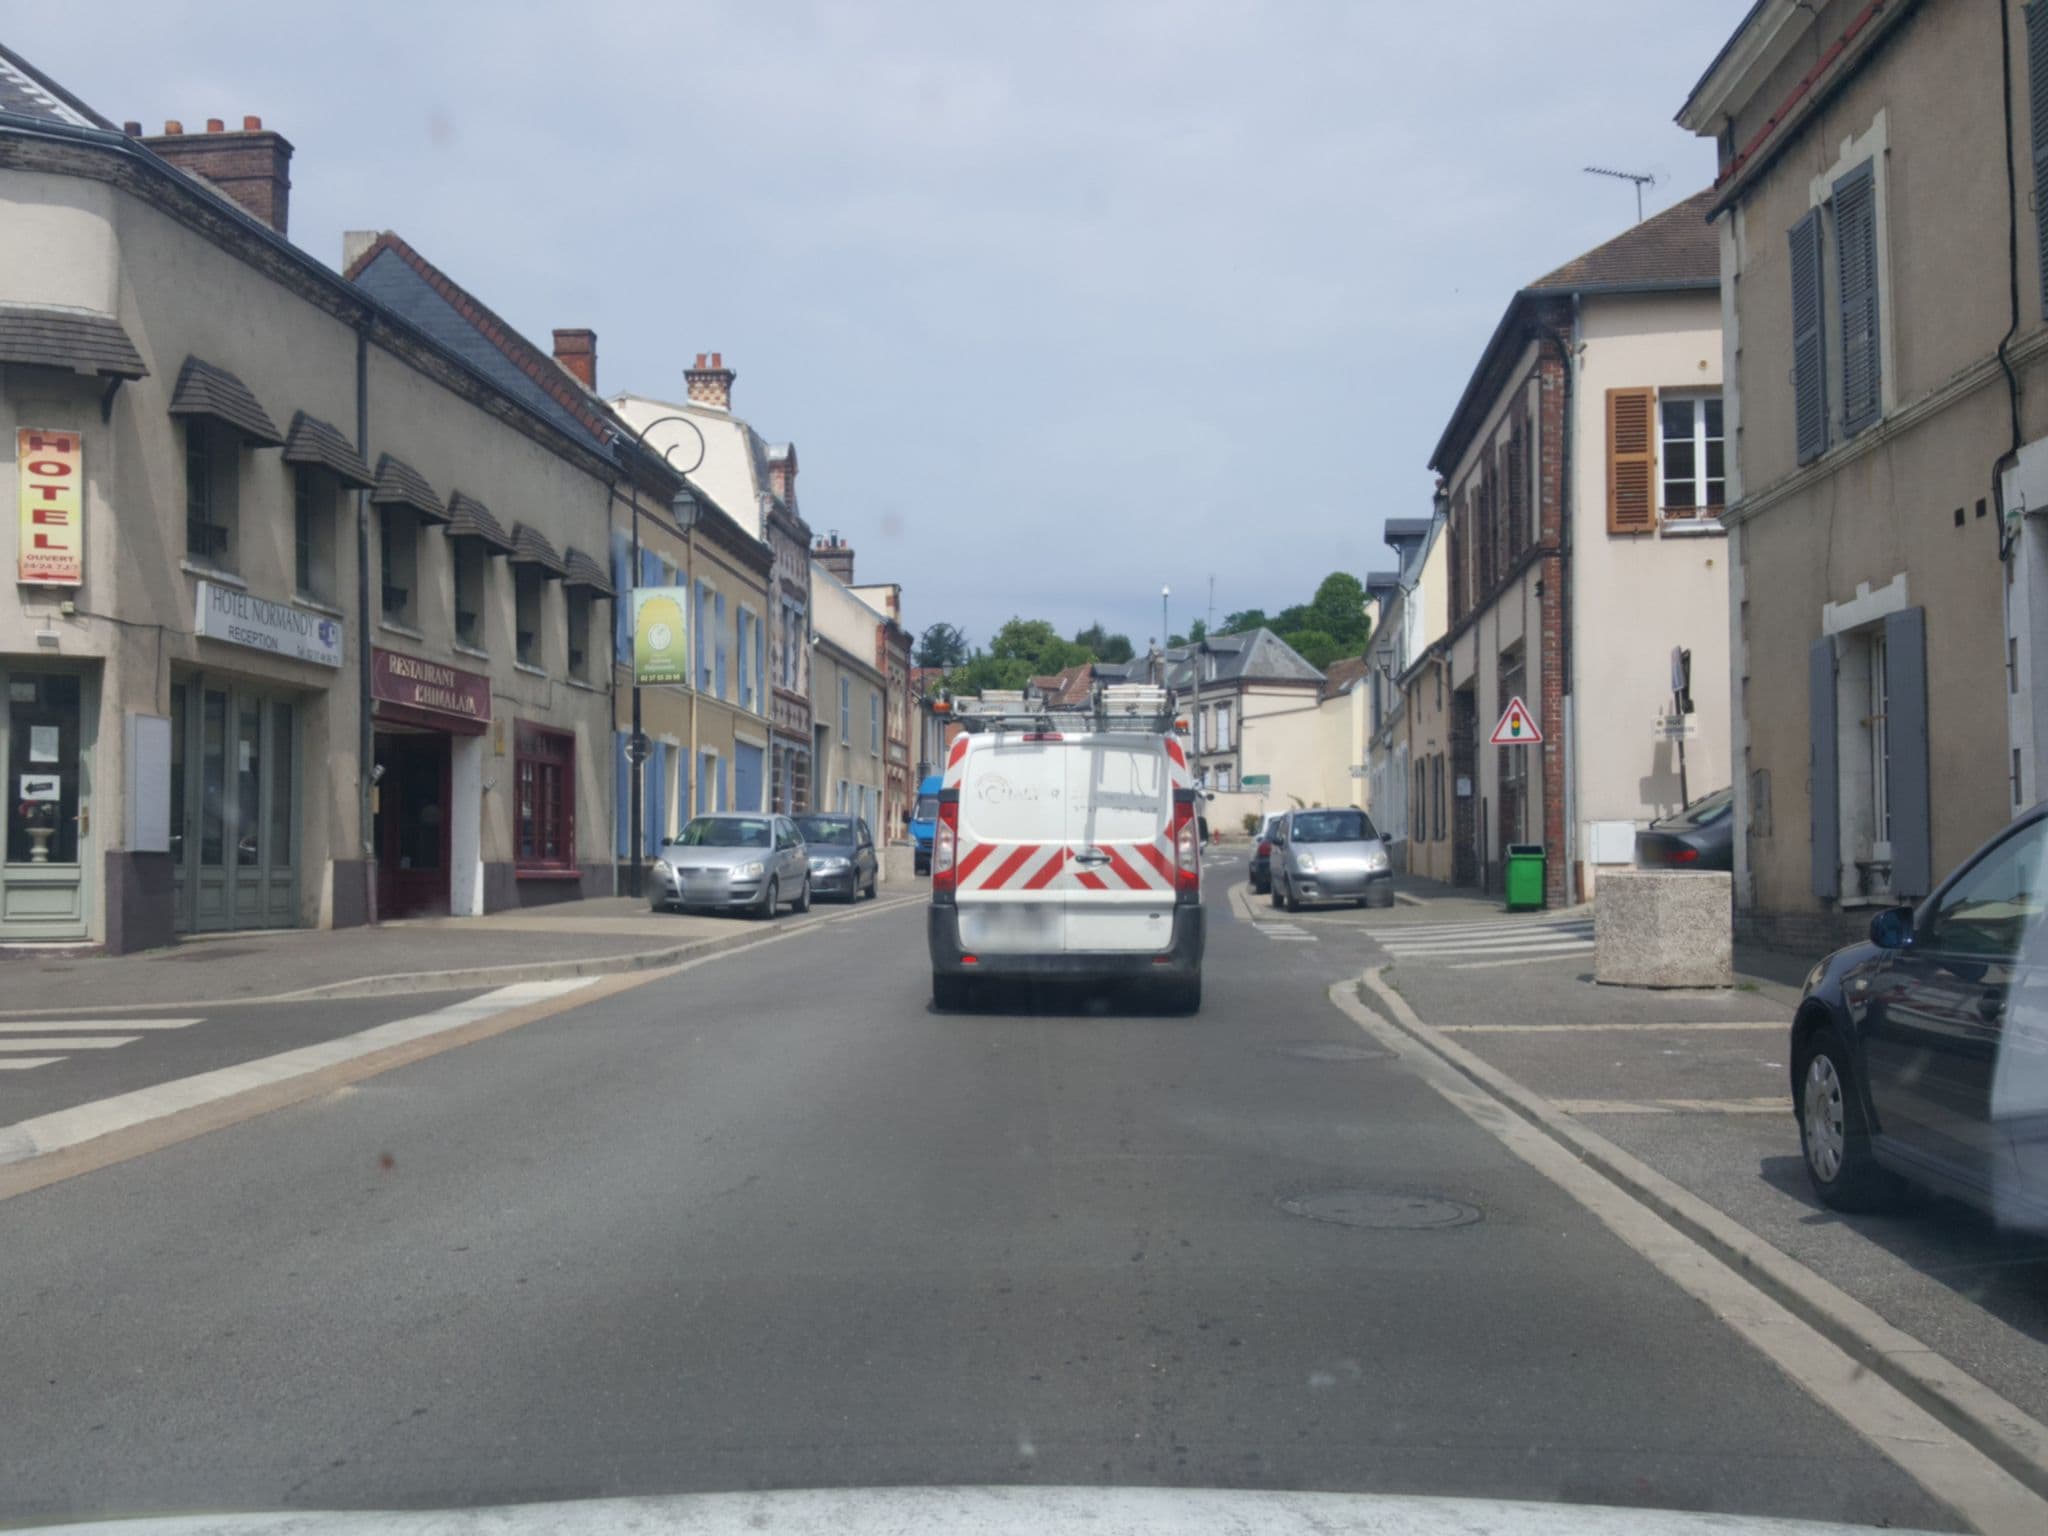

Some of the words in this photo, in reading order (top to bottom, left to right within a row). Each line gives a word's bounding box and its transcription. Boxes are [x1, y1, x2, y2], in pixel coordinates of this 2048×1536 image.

[28, 436, 72, 550] HOTEL
[26, 553, 74, 562] OUVERT
[212, 586, 249, 620] HOTEL
[251, 600, 315, 638] NORMANDY
[228, 624, 279, 649] RECEPTION
